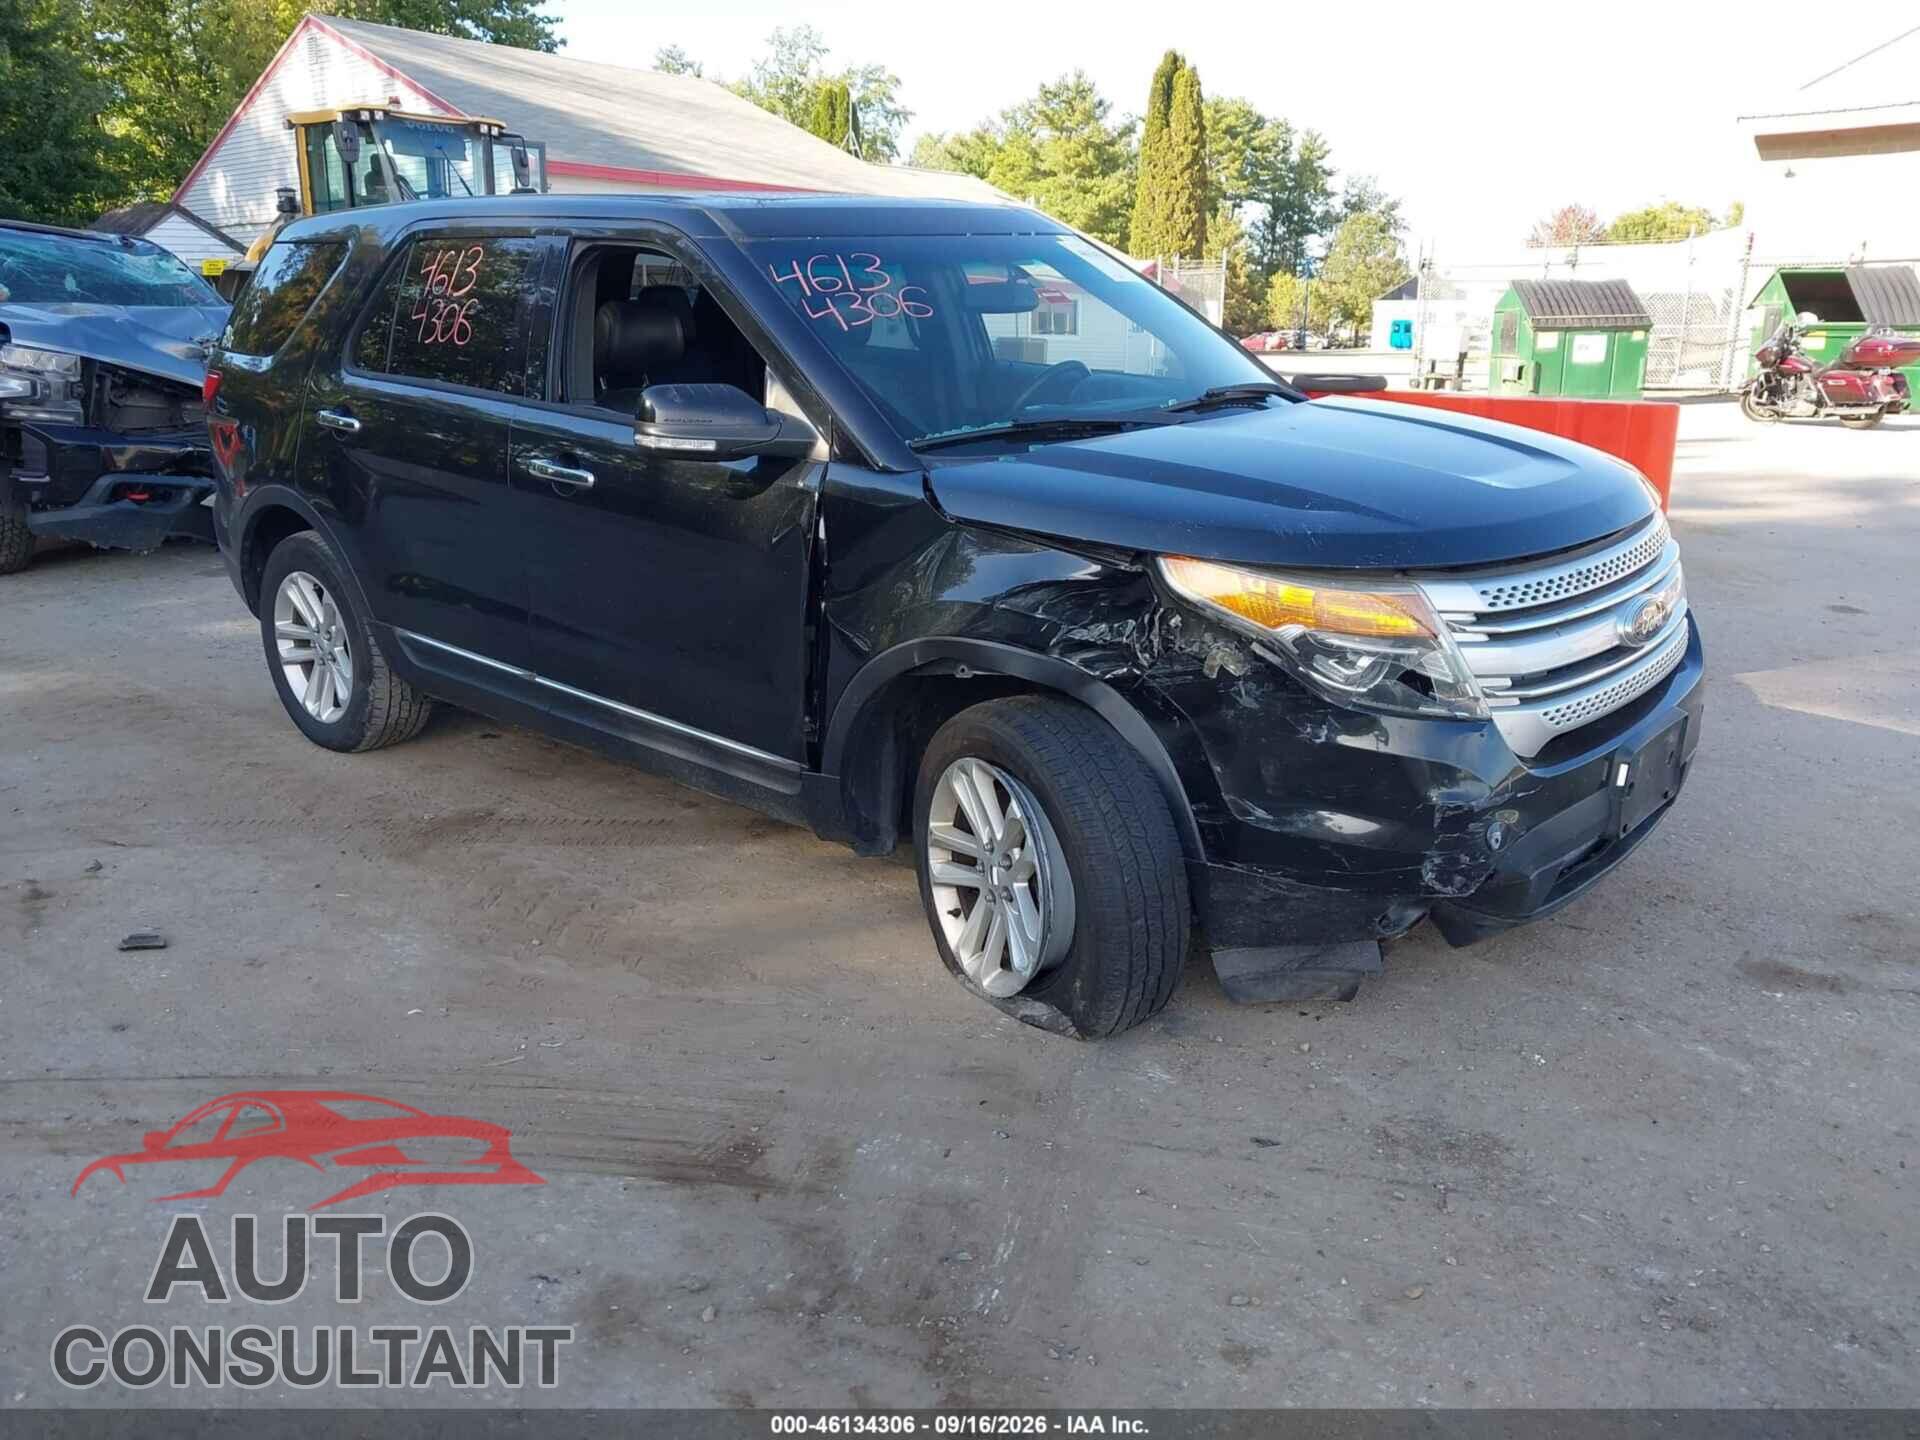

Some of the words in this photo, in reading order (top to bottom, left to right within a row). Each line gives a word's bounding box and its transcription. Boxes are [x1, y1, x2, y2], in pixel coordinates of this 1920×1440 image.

[420, 245, 484, 298] 4613
[769, 253, 890, 297] 4613
[411, 298, 479, 345] 4306
[801, 286, 934, 331] 4306
